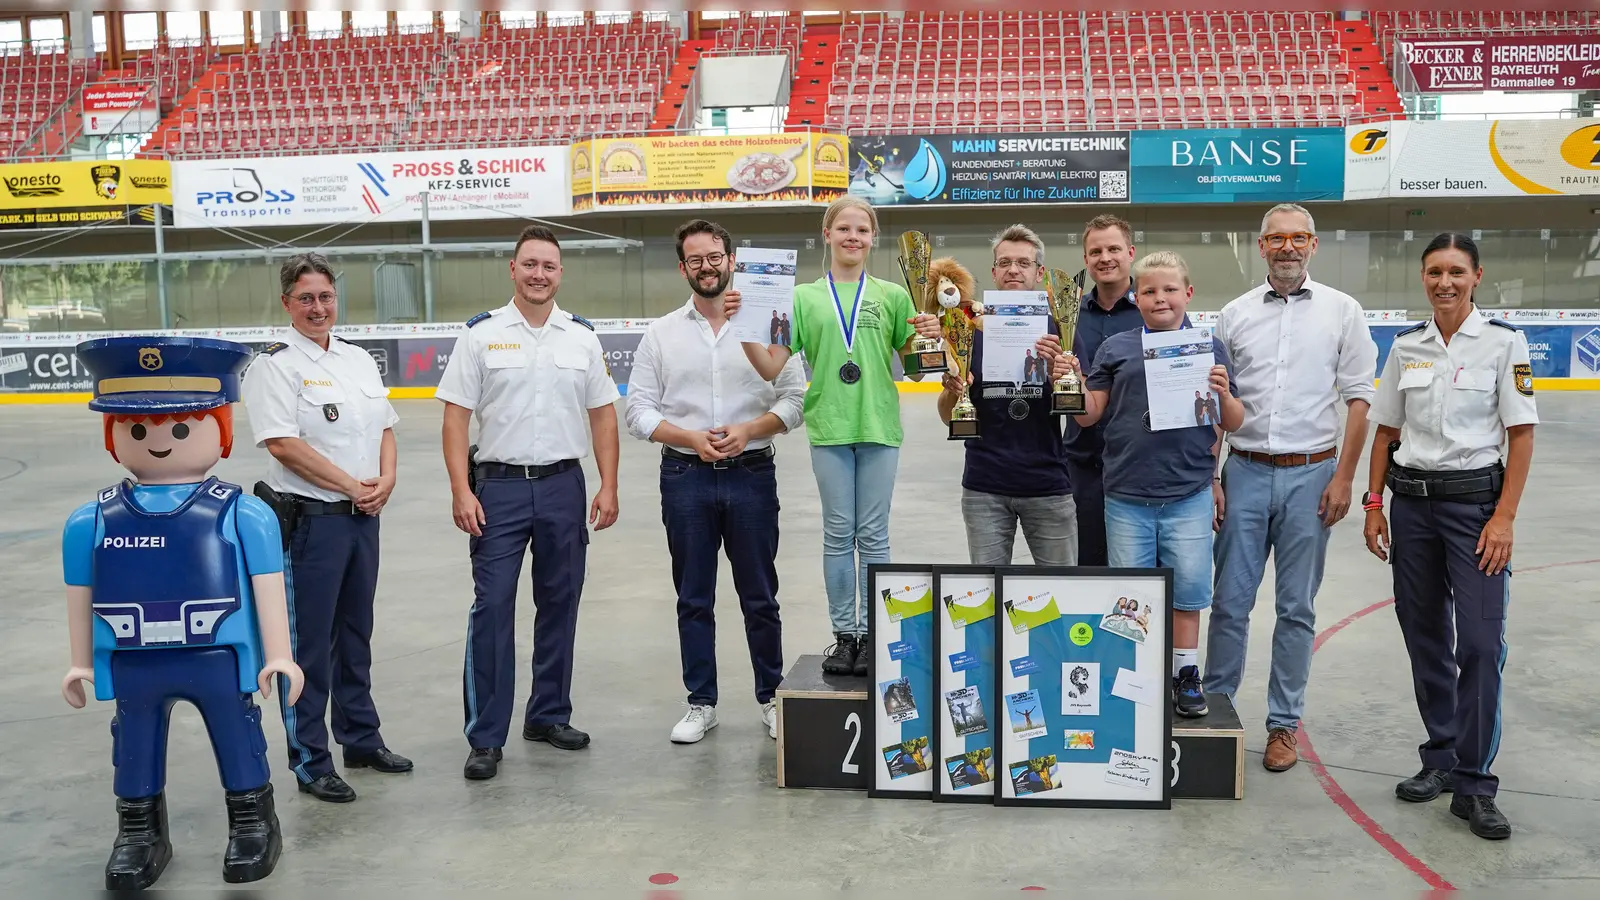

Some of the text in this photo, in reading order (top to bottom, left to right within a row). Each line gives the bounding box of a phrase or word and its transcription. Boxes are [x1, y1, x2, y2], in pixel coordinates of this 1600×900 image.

[1400, 42, 1484, 64] BECKER &
[1491, 43, 1600, 63] HERRENBEKLEID
[1491, 64, 1559, 75] BAYREUTH
[1428, 65, 1483, 88] EXNER
[1490, 76, 1576, 88] Dammallee 19
[106, 91, 133, 99] Sonntag
[652, 136, 802, 149] Wir backen das echte Holzofenbrot
[952, 137, 1126, 153] MAHN SERVICETECHNIK
[1172, 139, 1308, 166] BANSE
[392, 157, 546, 178] PROSS & SCHICK
[1022, 160, 1066, 168] BERATUNG
[10, 174, 61, 187] onesto
[952, 173, 988, 181] HEIZUNG
[993, 171, 1026, 180] SANITÄR
[1060, 171, 1097, 179] ELEKTRO
[1197, 174, 1282, 183] OBJEKTVERWALTUNG
[428, 178, 511, 190] KFZ-SERVICE
[1400, 177, 1487, 190] besser bauen.
[196, 190, 295, 205] PROSS
[952, 185, 1097, 200] Effizienz für Ihre Zukunft!
[24, 214, 34, 222] IN
[36, 213, 58, 222] GELB
[59, 212, 79, 221] UND
[80, 210, 125, 220] SCHWARZ.
[204, 207, 291, 219] Transporte
[1404, 361, 1433, 370] POLIZEI
[303, 379, 333, 387] POLIZEI
[103, 537, 165, 549] POLIZEI
[842, 712, 861, 774] 2
